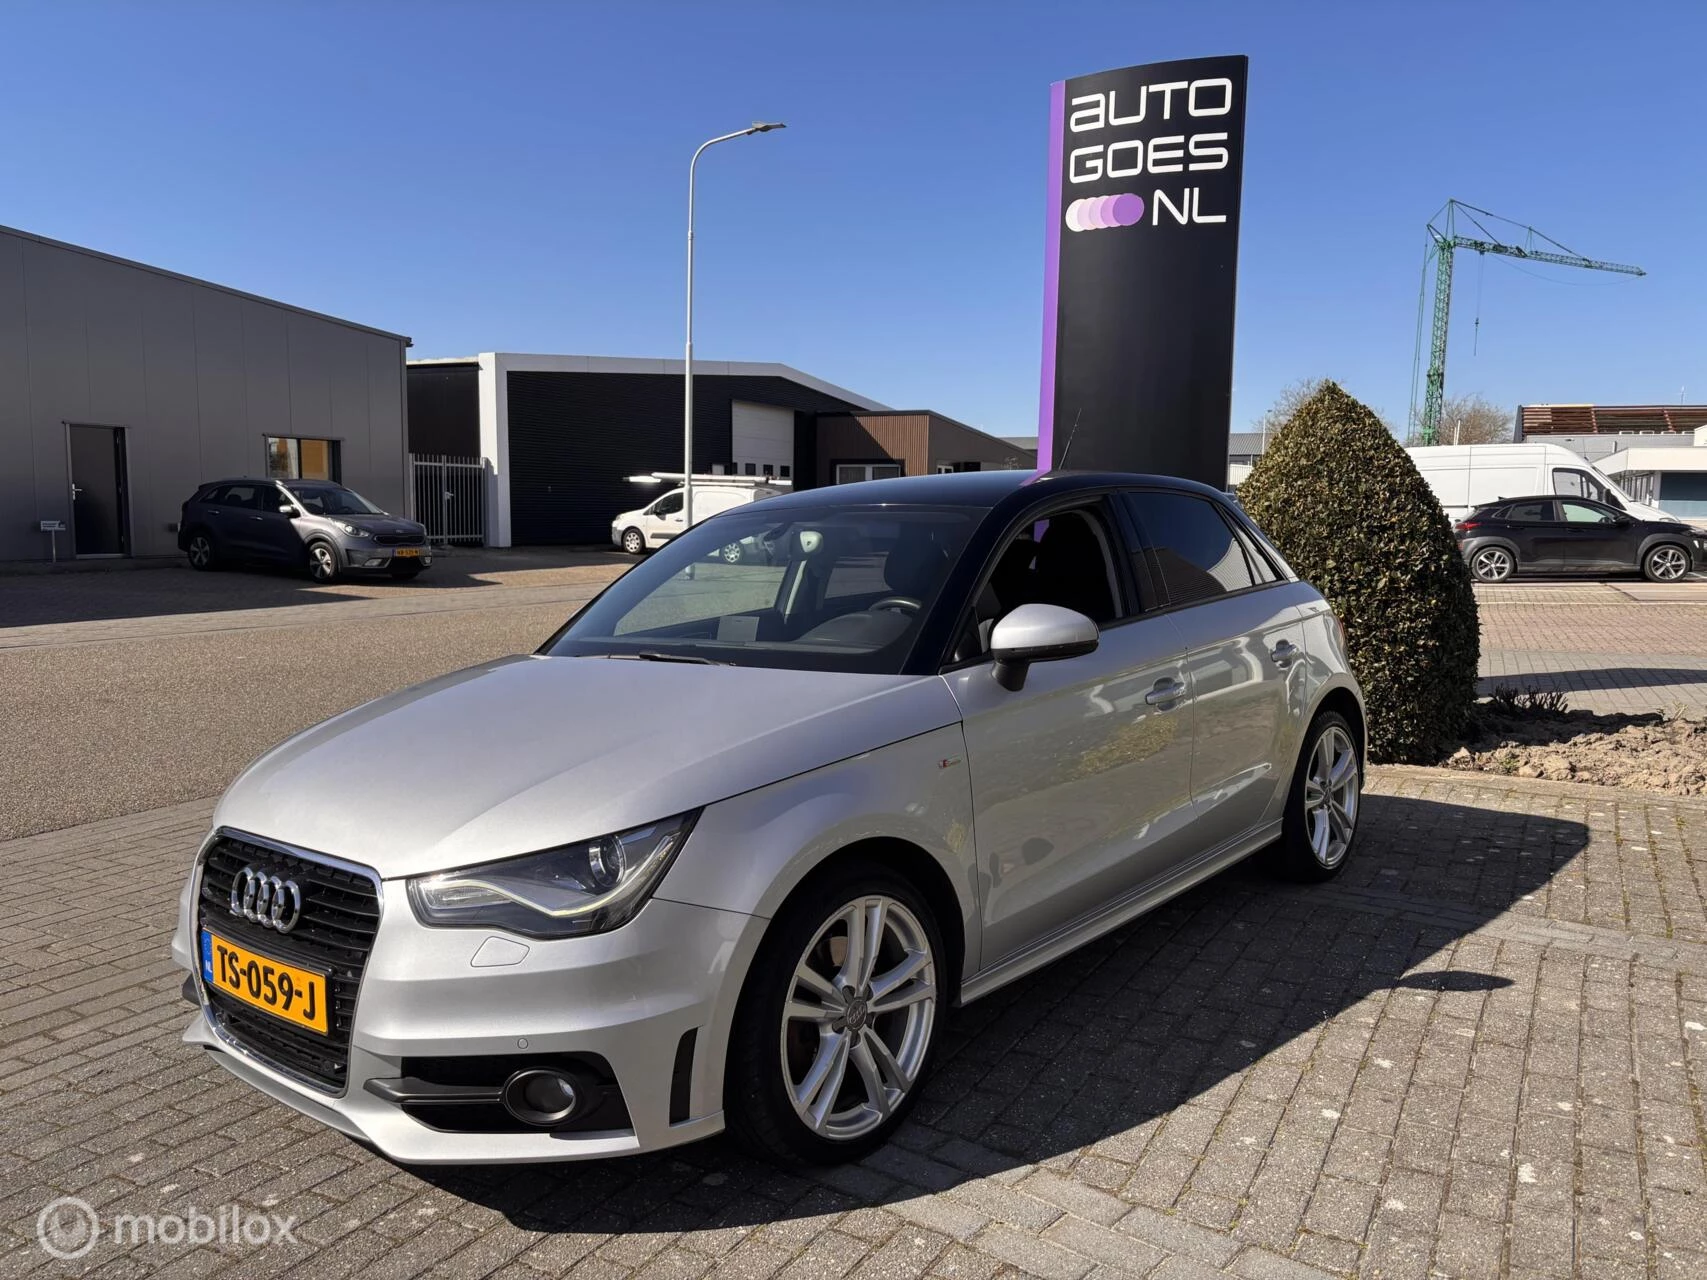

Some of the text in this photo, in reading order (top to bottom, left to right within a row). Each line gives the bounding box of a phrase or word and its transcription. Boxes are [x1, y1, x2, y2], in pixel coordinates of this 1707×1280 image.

[1069, 132, 1229, 184] GOES
[1152, 187, 1227, 226] NL
[217, 944, 316, 1021] TS-059-J
